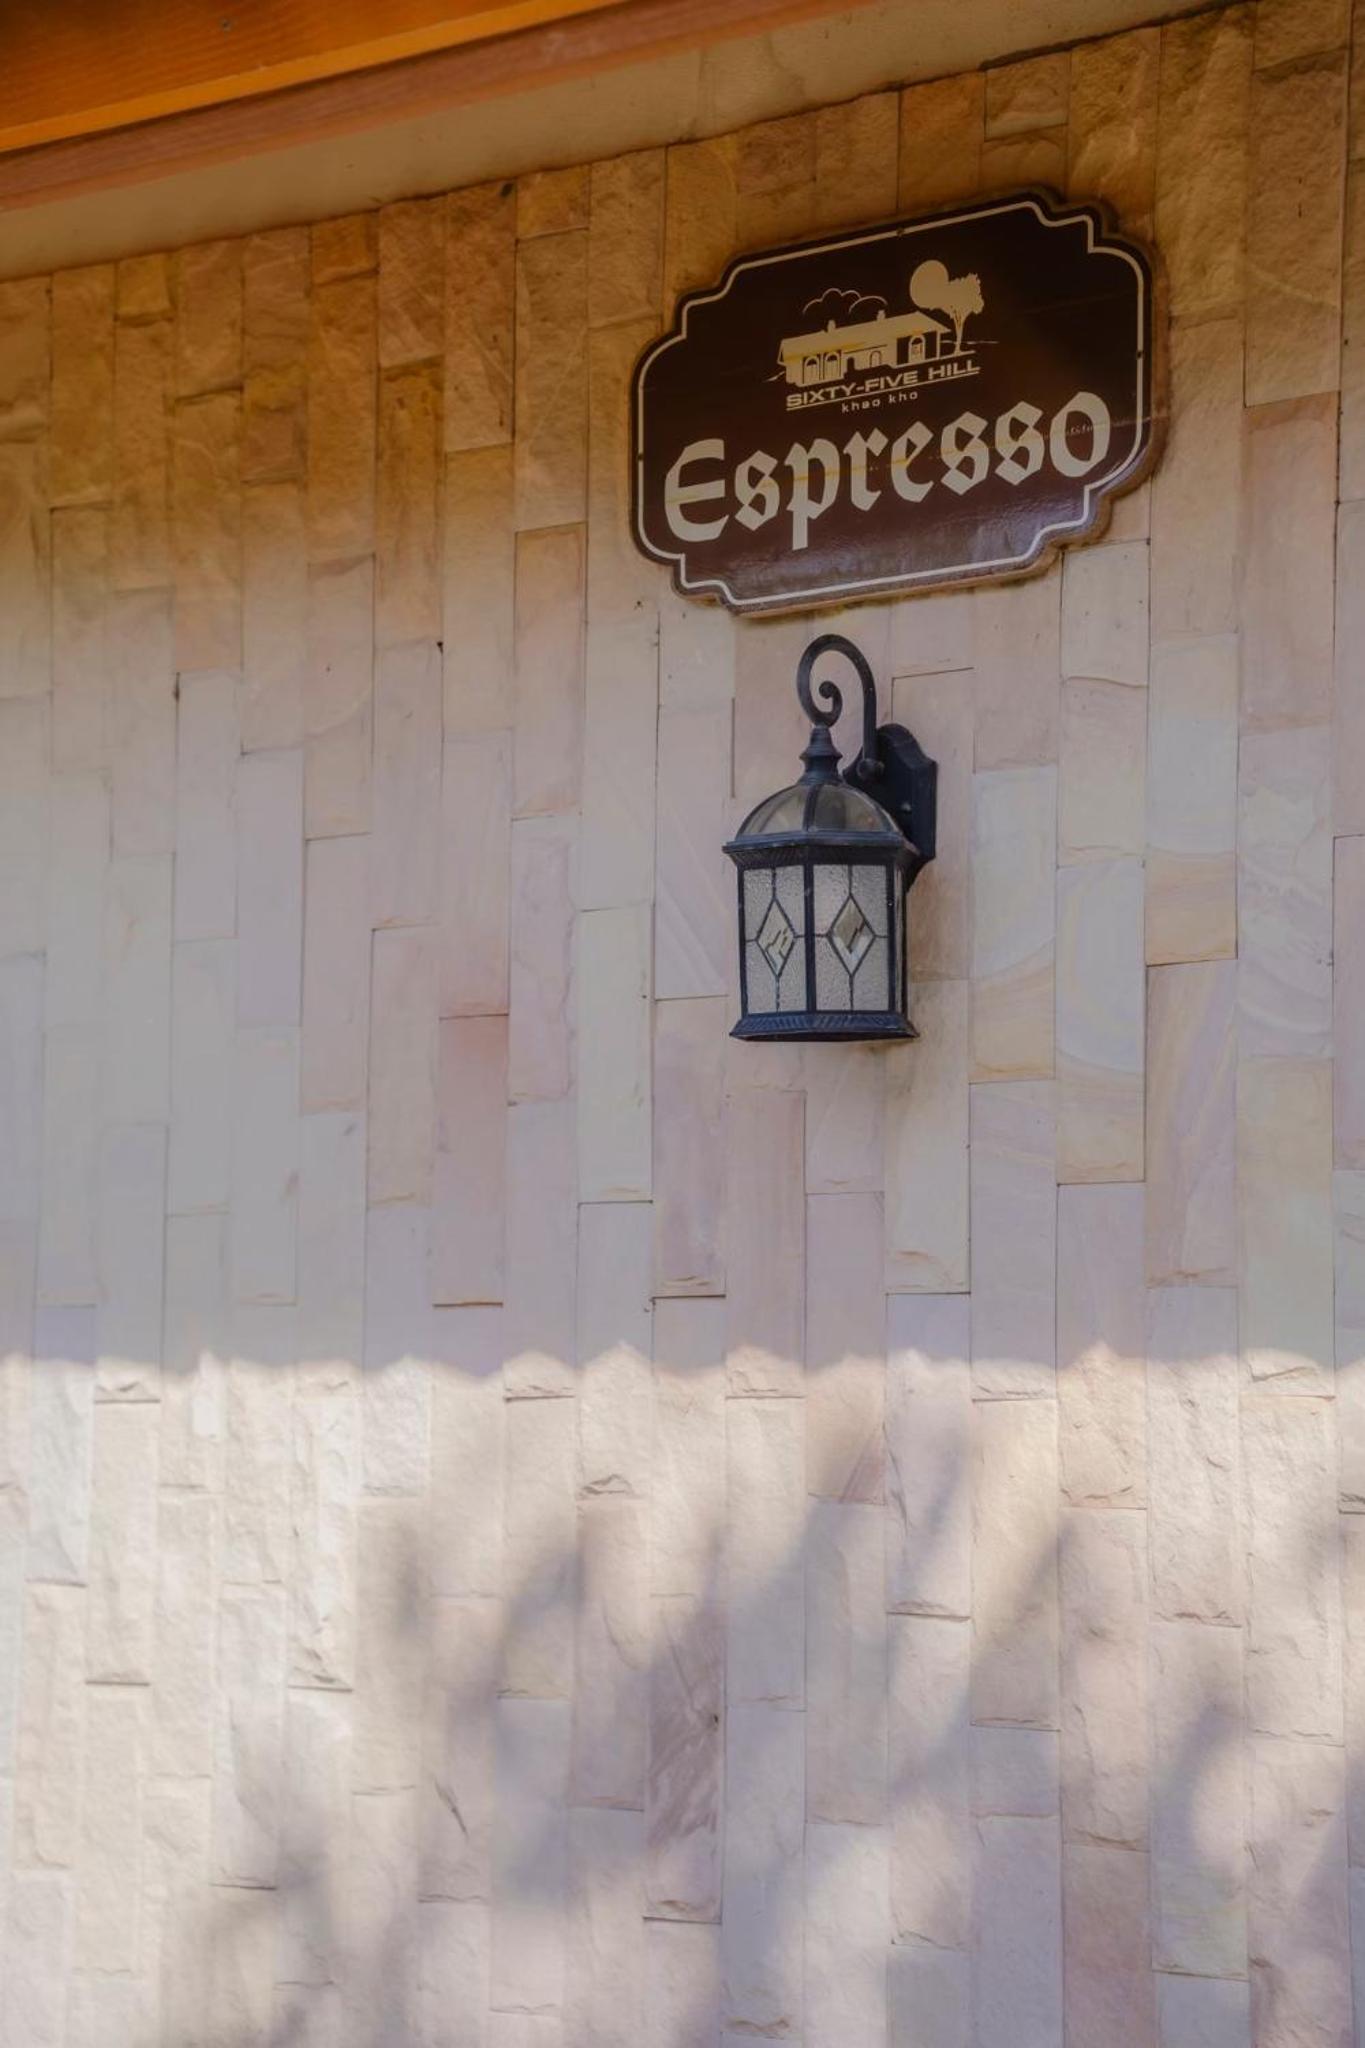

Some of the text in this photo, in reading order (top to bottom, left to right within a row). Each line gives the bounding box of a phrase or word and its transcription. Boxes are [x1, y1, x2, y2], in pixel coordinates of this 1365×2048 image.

[786, 360, 981, 408] SIXTY-FIVE HILL
[841, 391, 918, 413] khao kho
[664, 391, 1110, 550] Espresso
